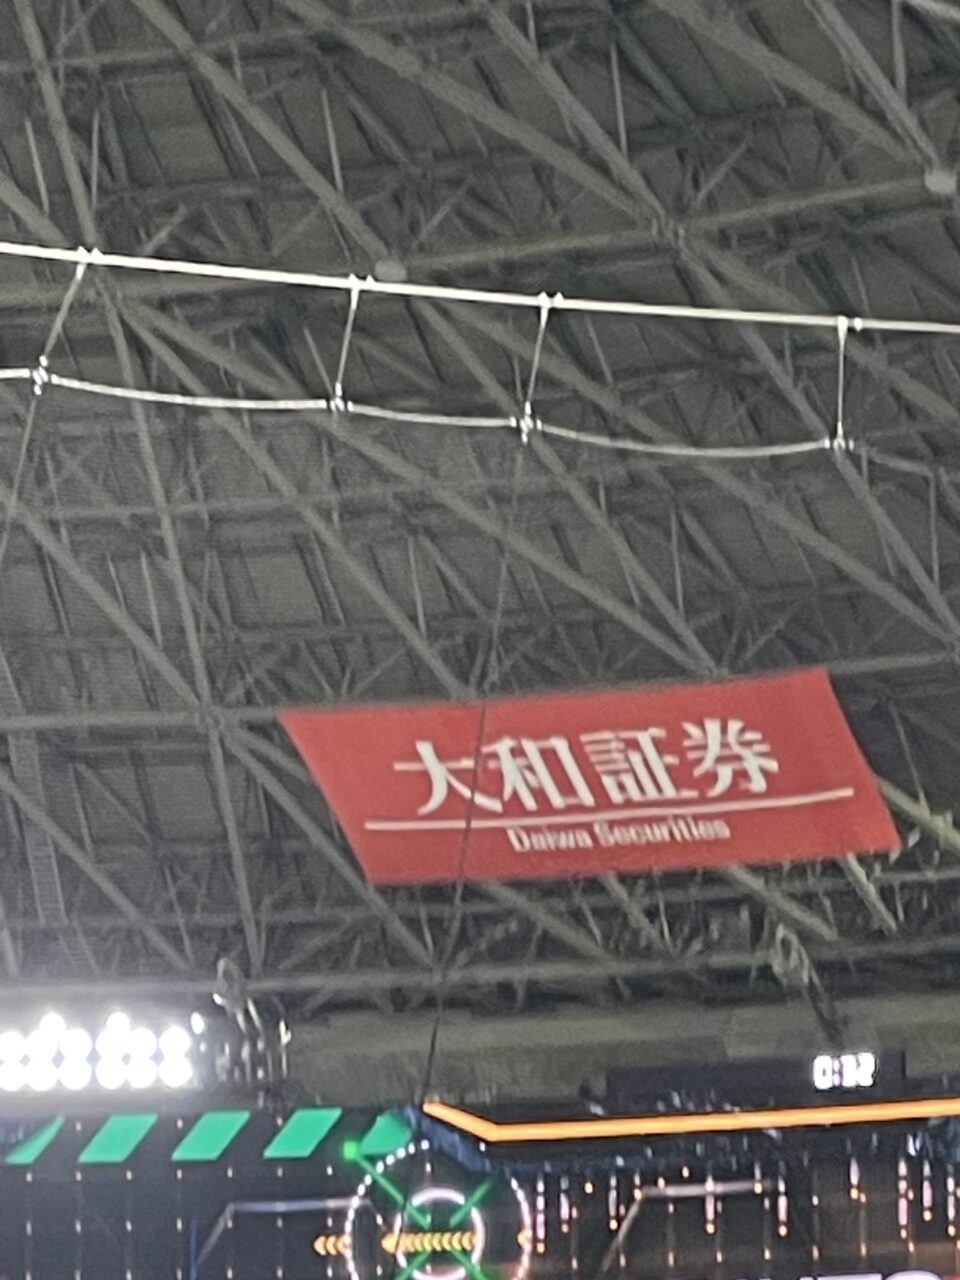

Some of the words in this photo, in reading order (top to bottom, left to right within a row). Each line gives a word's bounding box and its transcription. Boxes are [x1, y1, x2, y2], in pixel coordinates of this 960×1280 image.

[393, 718, 778, 816] 大和証券
[506, 823, 594, 852] Daiwa
[593, 815, 731, 847] Securities
